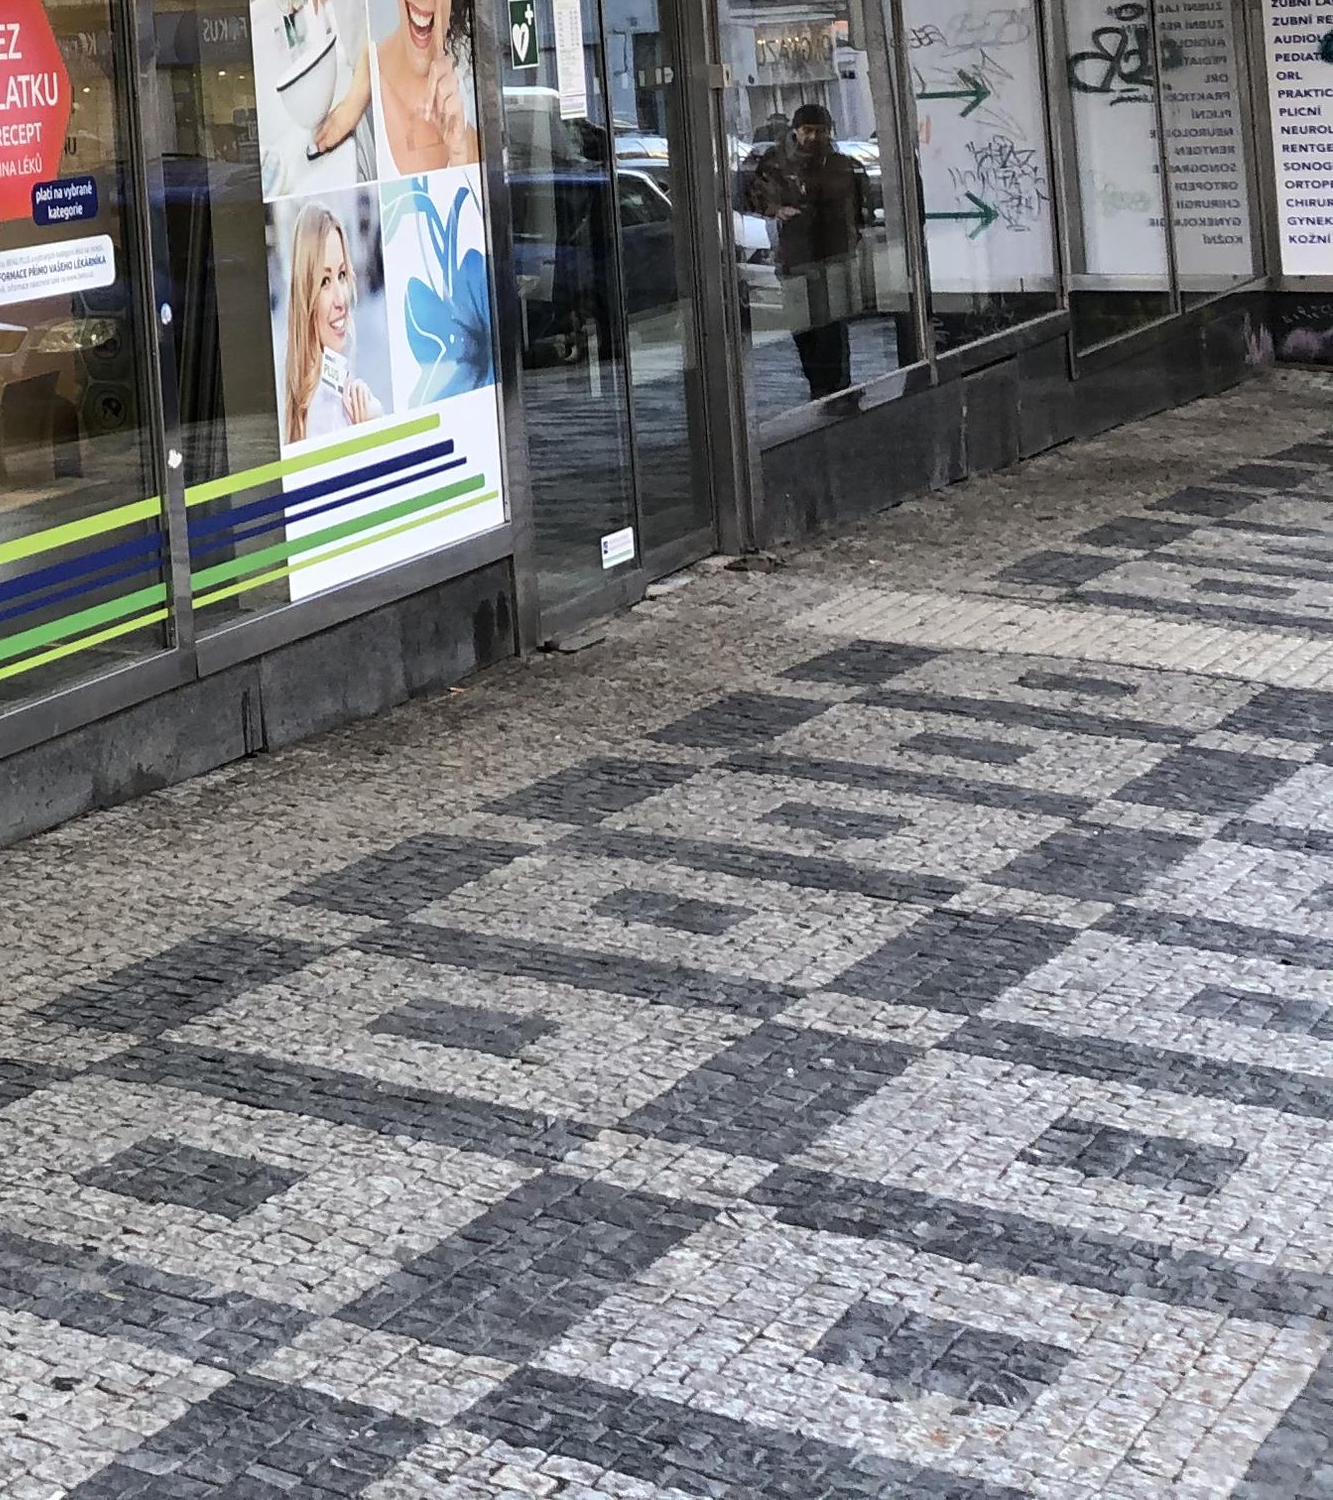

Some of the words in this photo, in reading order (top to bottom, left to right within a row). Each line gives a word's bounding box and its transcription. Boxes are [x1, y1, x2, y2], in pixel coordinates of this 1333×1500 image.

[1272, 14, 1312, 26] ZUBNÍ
[1276, 71, 1302, 80] ORL
[1279, 105, 1321, 117] PLICNÍ
[18, 153, 42, 176] LÉKŮ
[53, 187, 62, 199] na
[63, 180, 92, 200] vybrané
[48, 202, 83, 220] kategorie
[1289, 233, 1331, 244] KOŽNÍ
